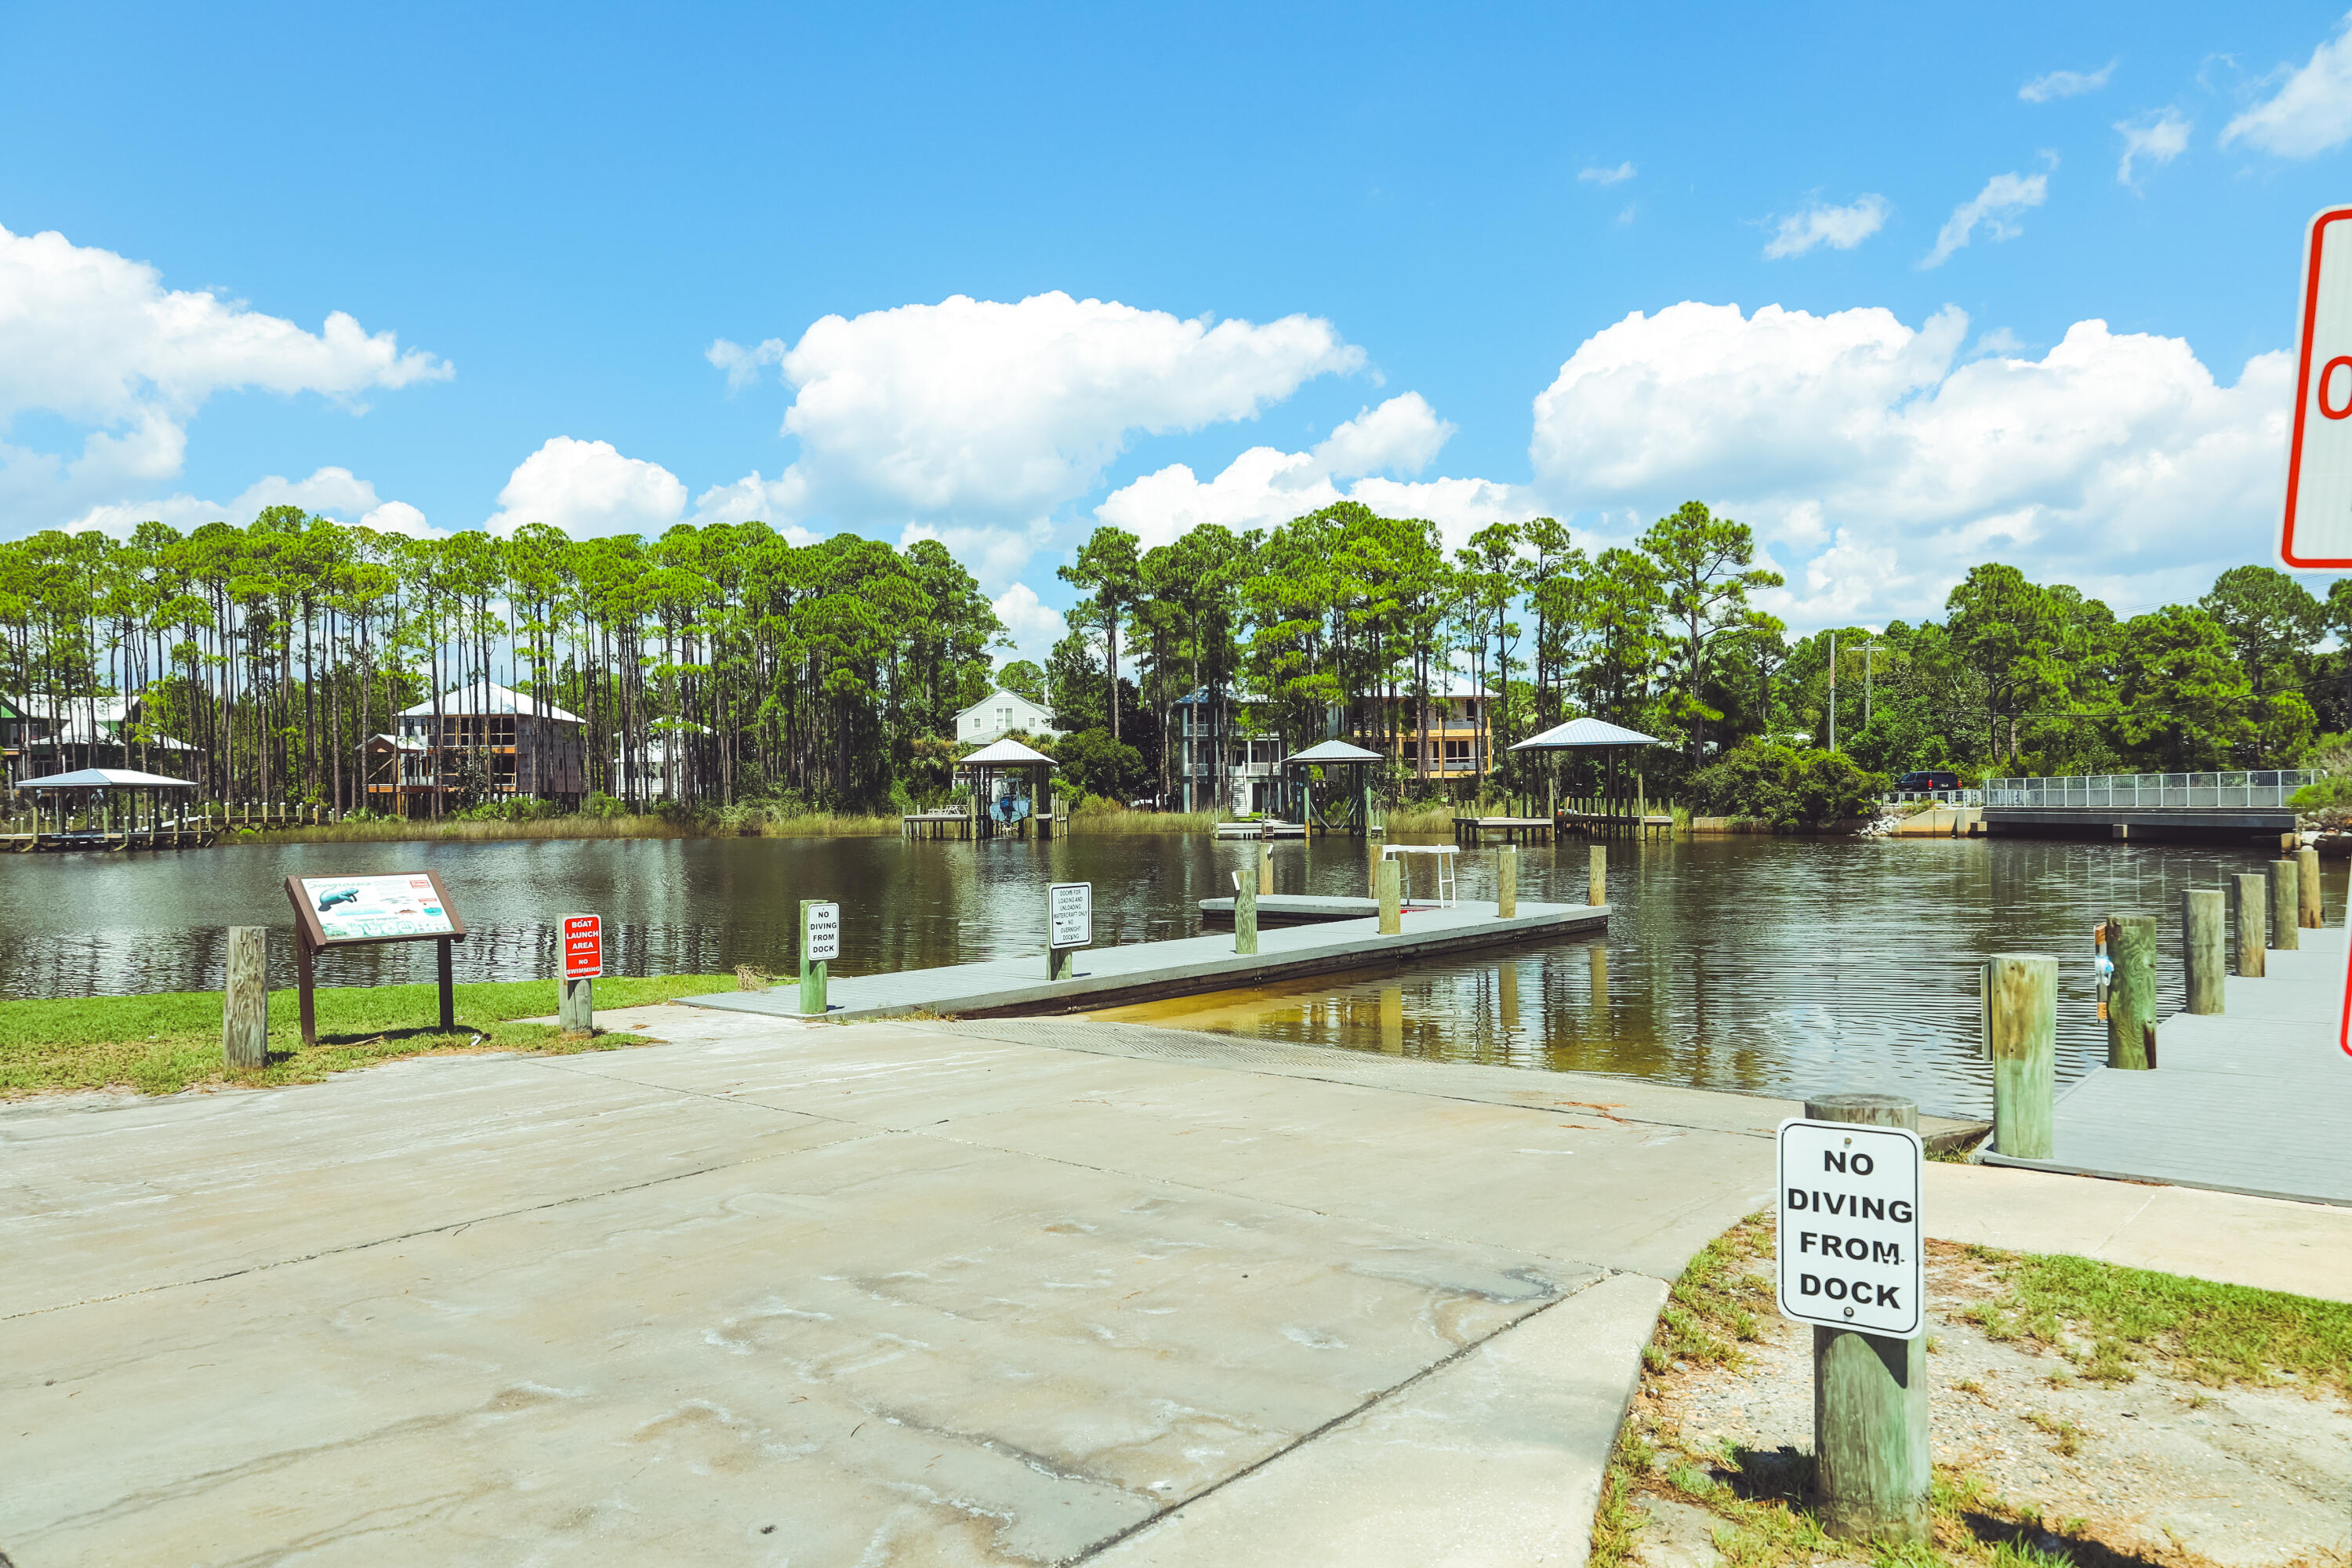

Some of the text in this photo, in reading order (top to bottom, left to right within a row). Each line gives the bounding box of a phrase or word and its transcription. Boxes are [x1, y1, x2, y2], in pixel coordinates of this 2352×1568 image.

[566, 931, 598, 939] LAUNCH
[566, 966, 601, 975] SWIMMING
[1824, 1150, 1874, 1175] NO
[1788, 1188, 1912, 1223] DIVING
[1801, 1231, 1900, 1265] FROM
[1801, 1272, 1900, 1309] DOCK
